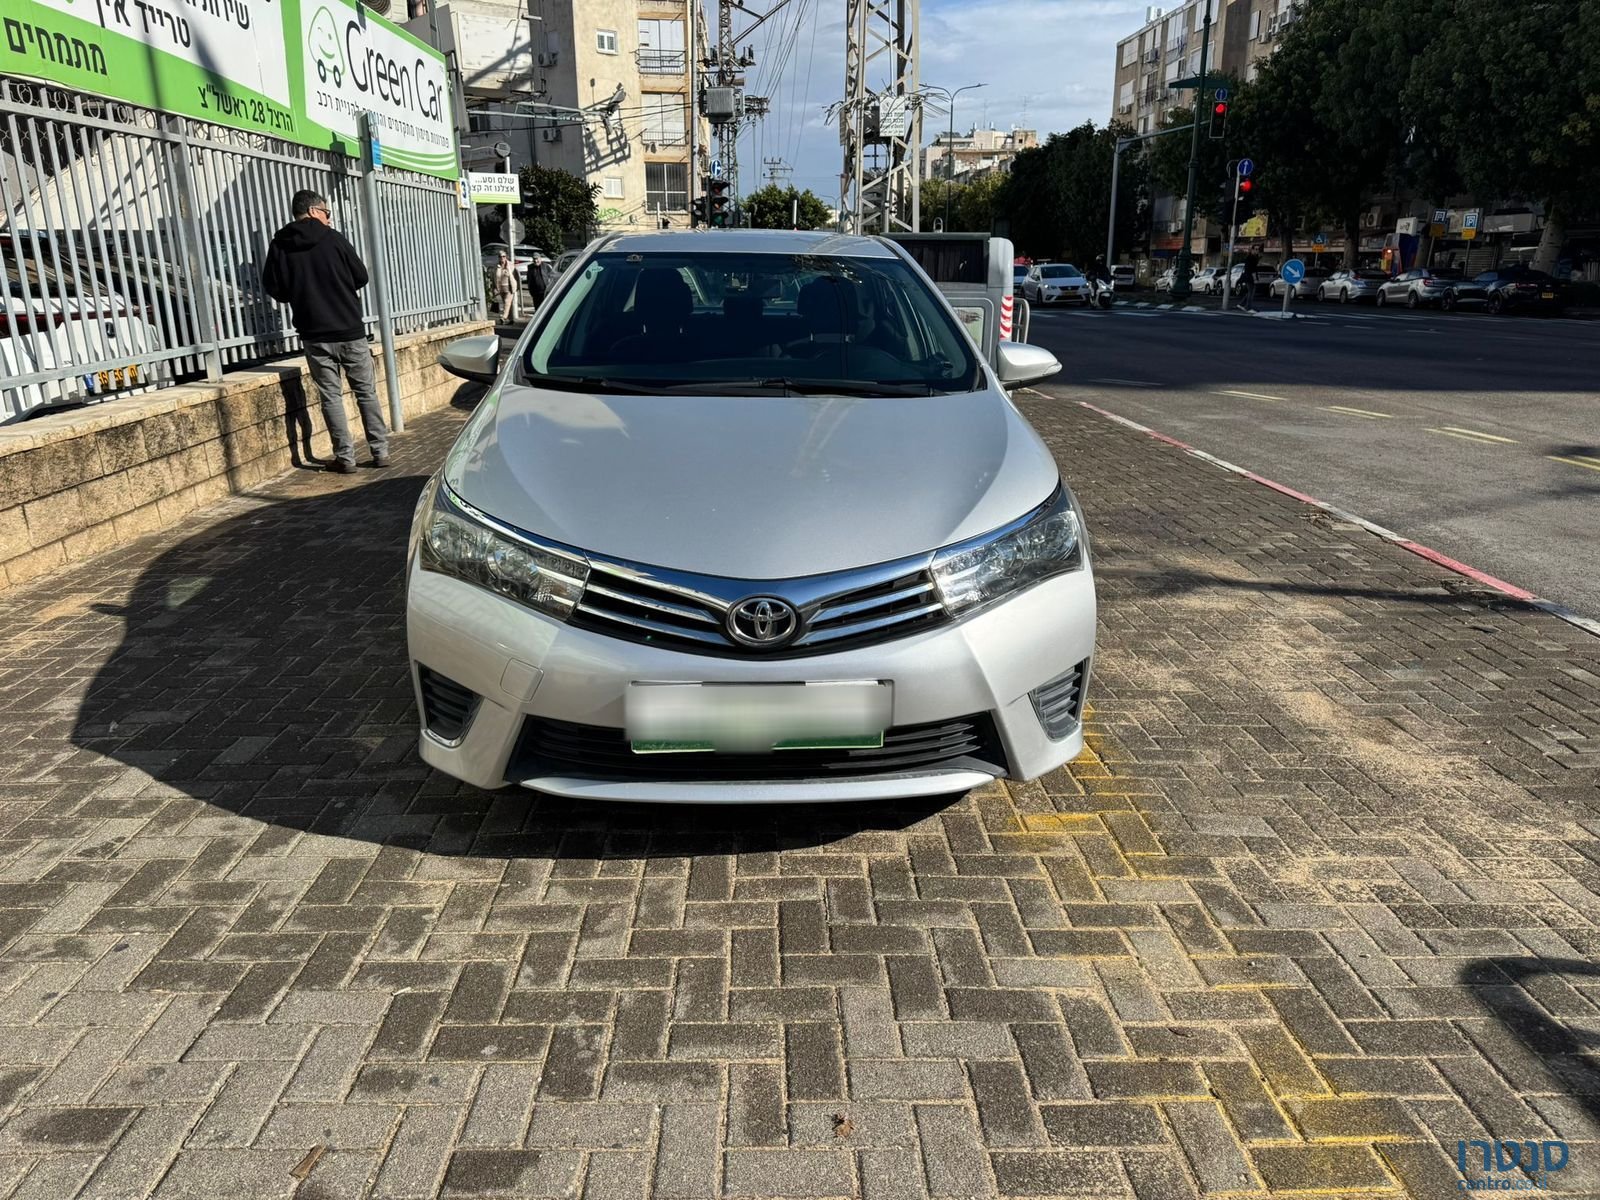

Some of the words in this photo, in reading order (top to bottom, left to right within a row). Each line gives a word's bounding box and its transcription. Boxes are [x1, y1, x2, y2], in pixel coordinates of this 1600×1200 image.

[134, 0, 191, 48] טרייד
[3, 17, 107, 75] מתמחים
[346, 20, 414, 111] Green
[415, 58, 442, 123] Car
[250, 98, 265, 124] 28
[316, 90, 333, 109] רכב
[266, 102, 293, 132] הרצל
[494, 184, 515, 192] אצלנו
[497, 176, 515, 185] שלם
